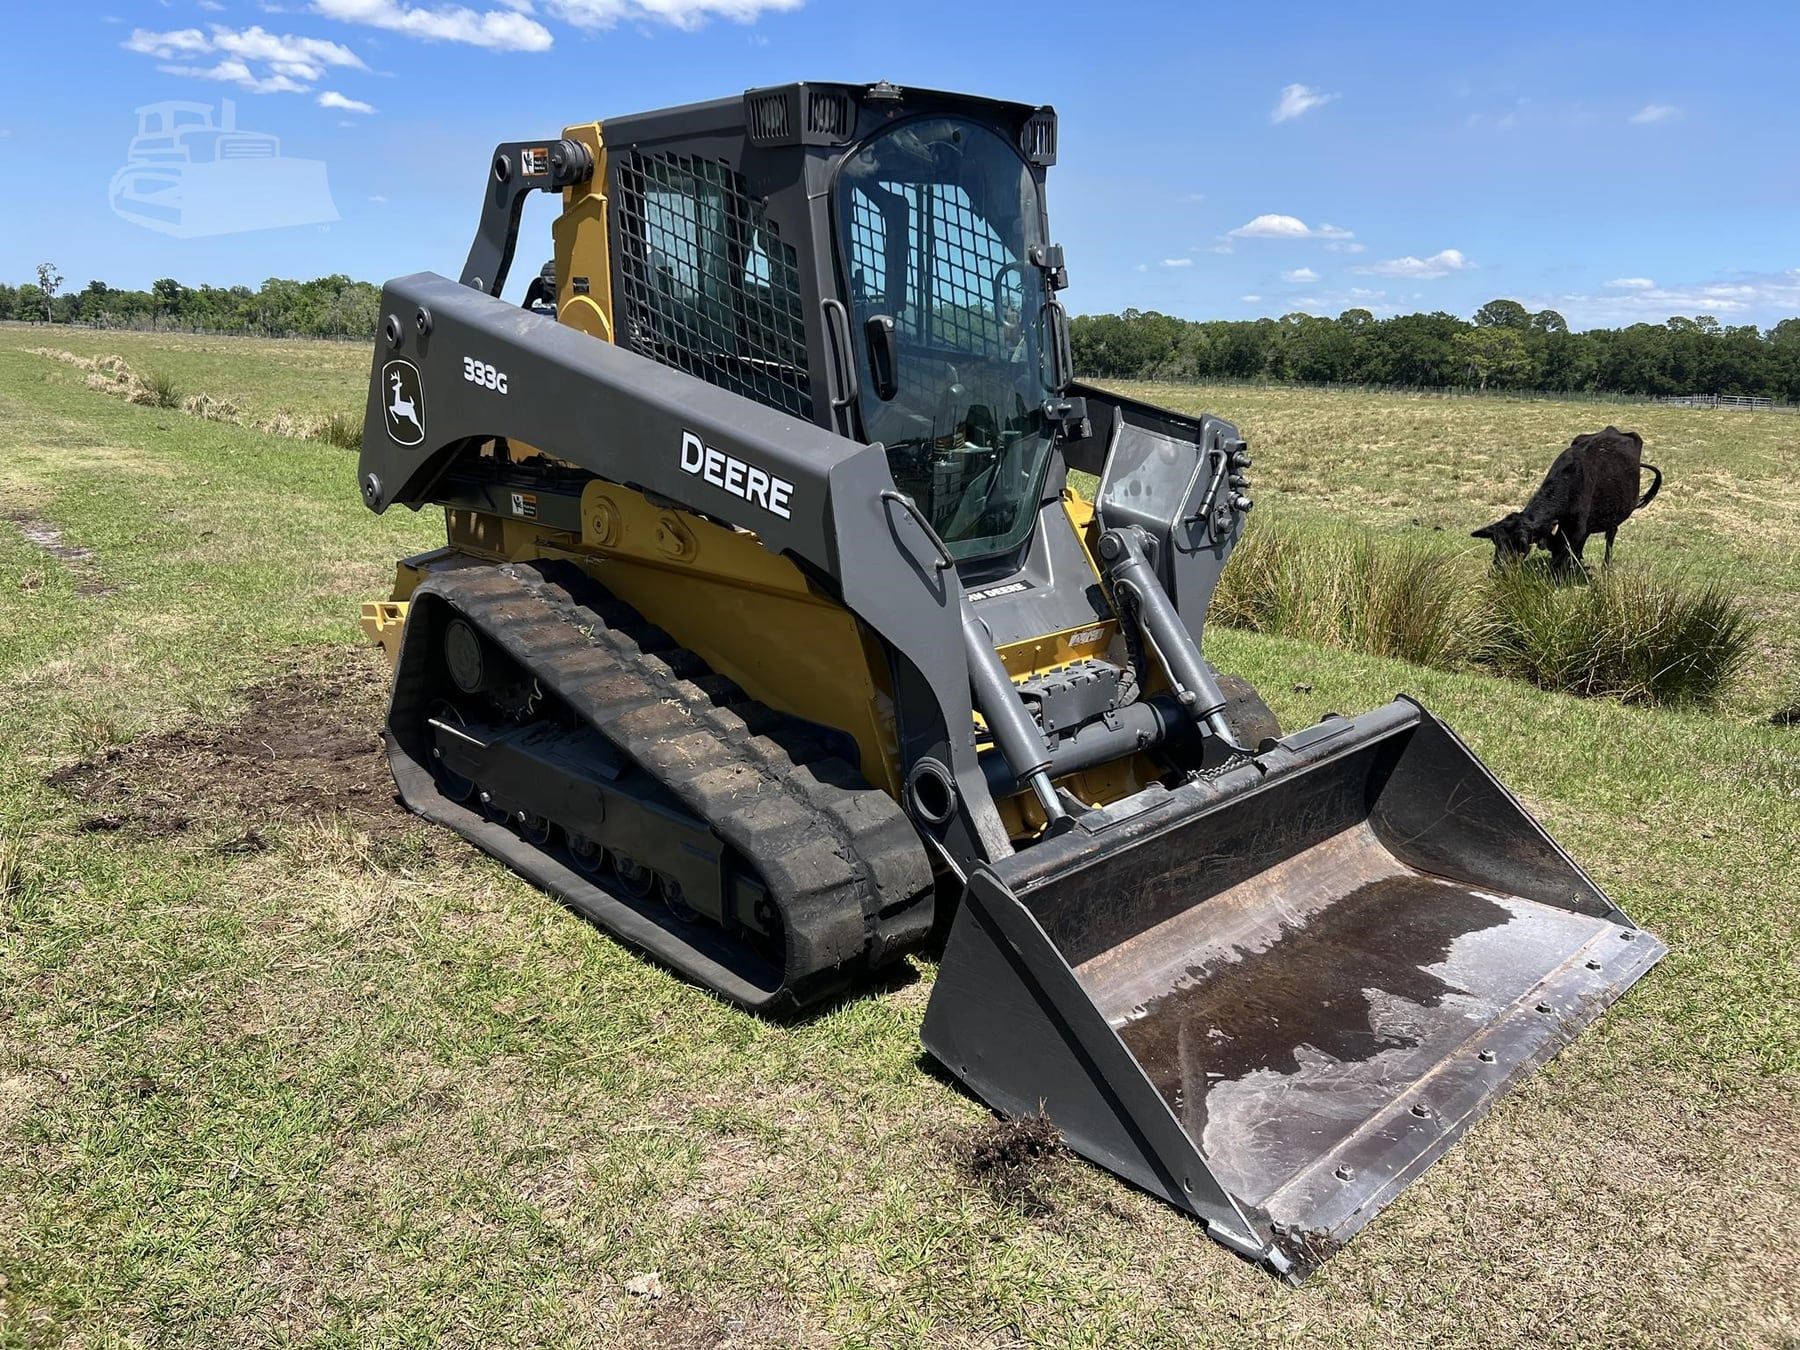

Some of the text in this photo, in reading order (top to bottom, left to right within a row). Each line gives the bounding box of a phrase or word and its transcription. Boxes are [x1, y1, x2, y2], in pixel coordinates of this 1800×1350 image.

[463, 356, 508, 395] 333G
[680, 430, 794, 520] DEERE
[983, 582, 1027, 598] DEERE
